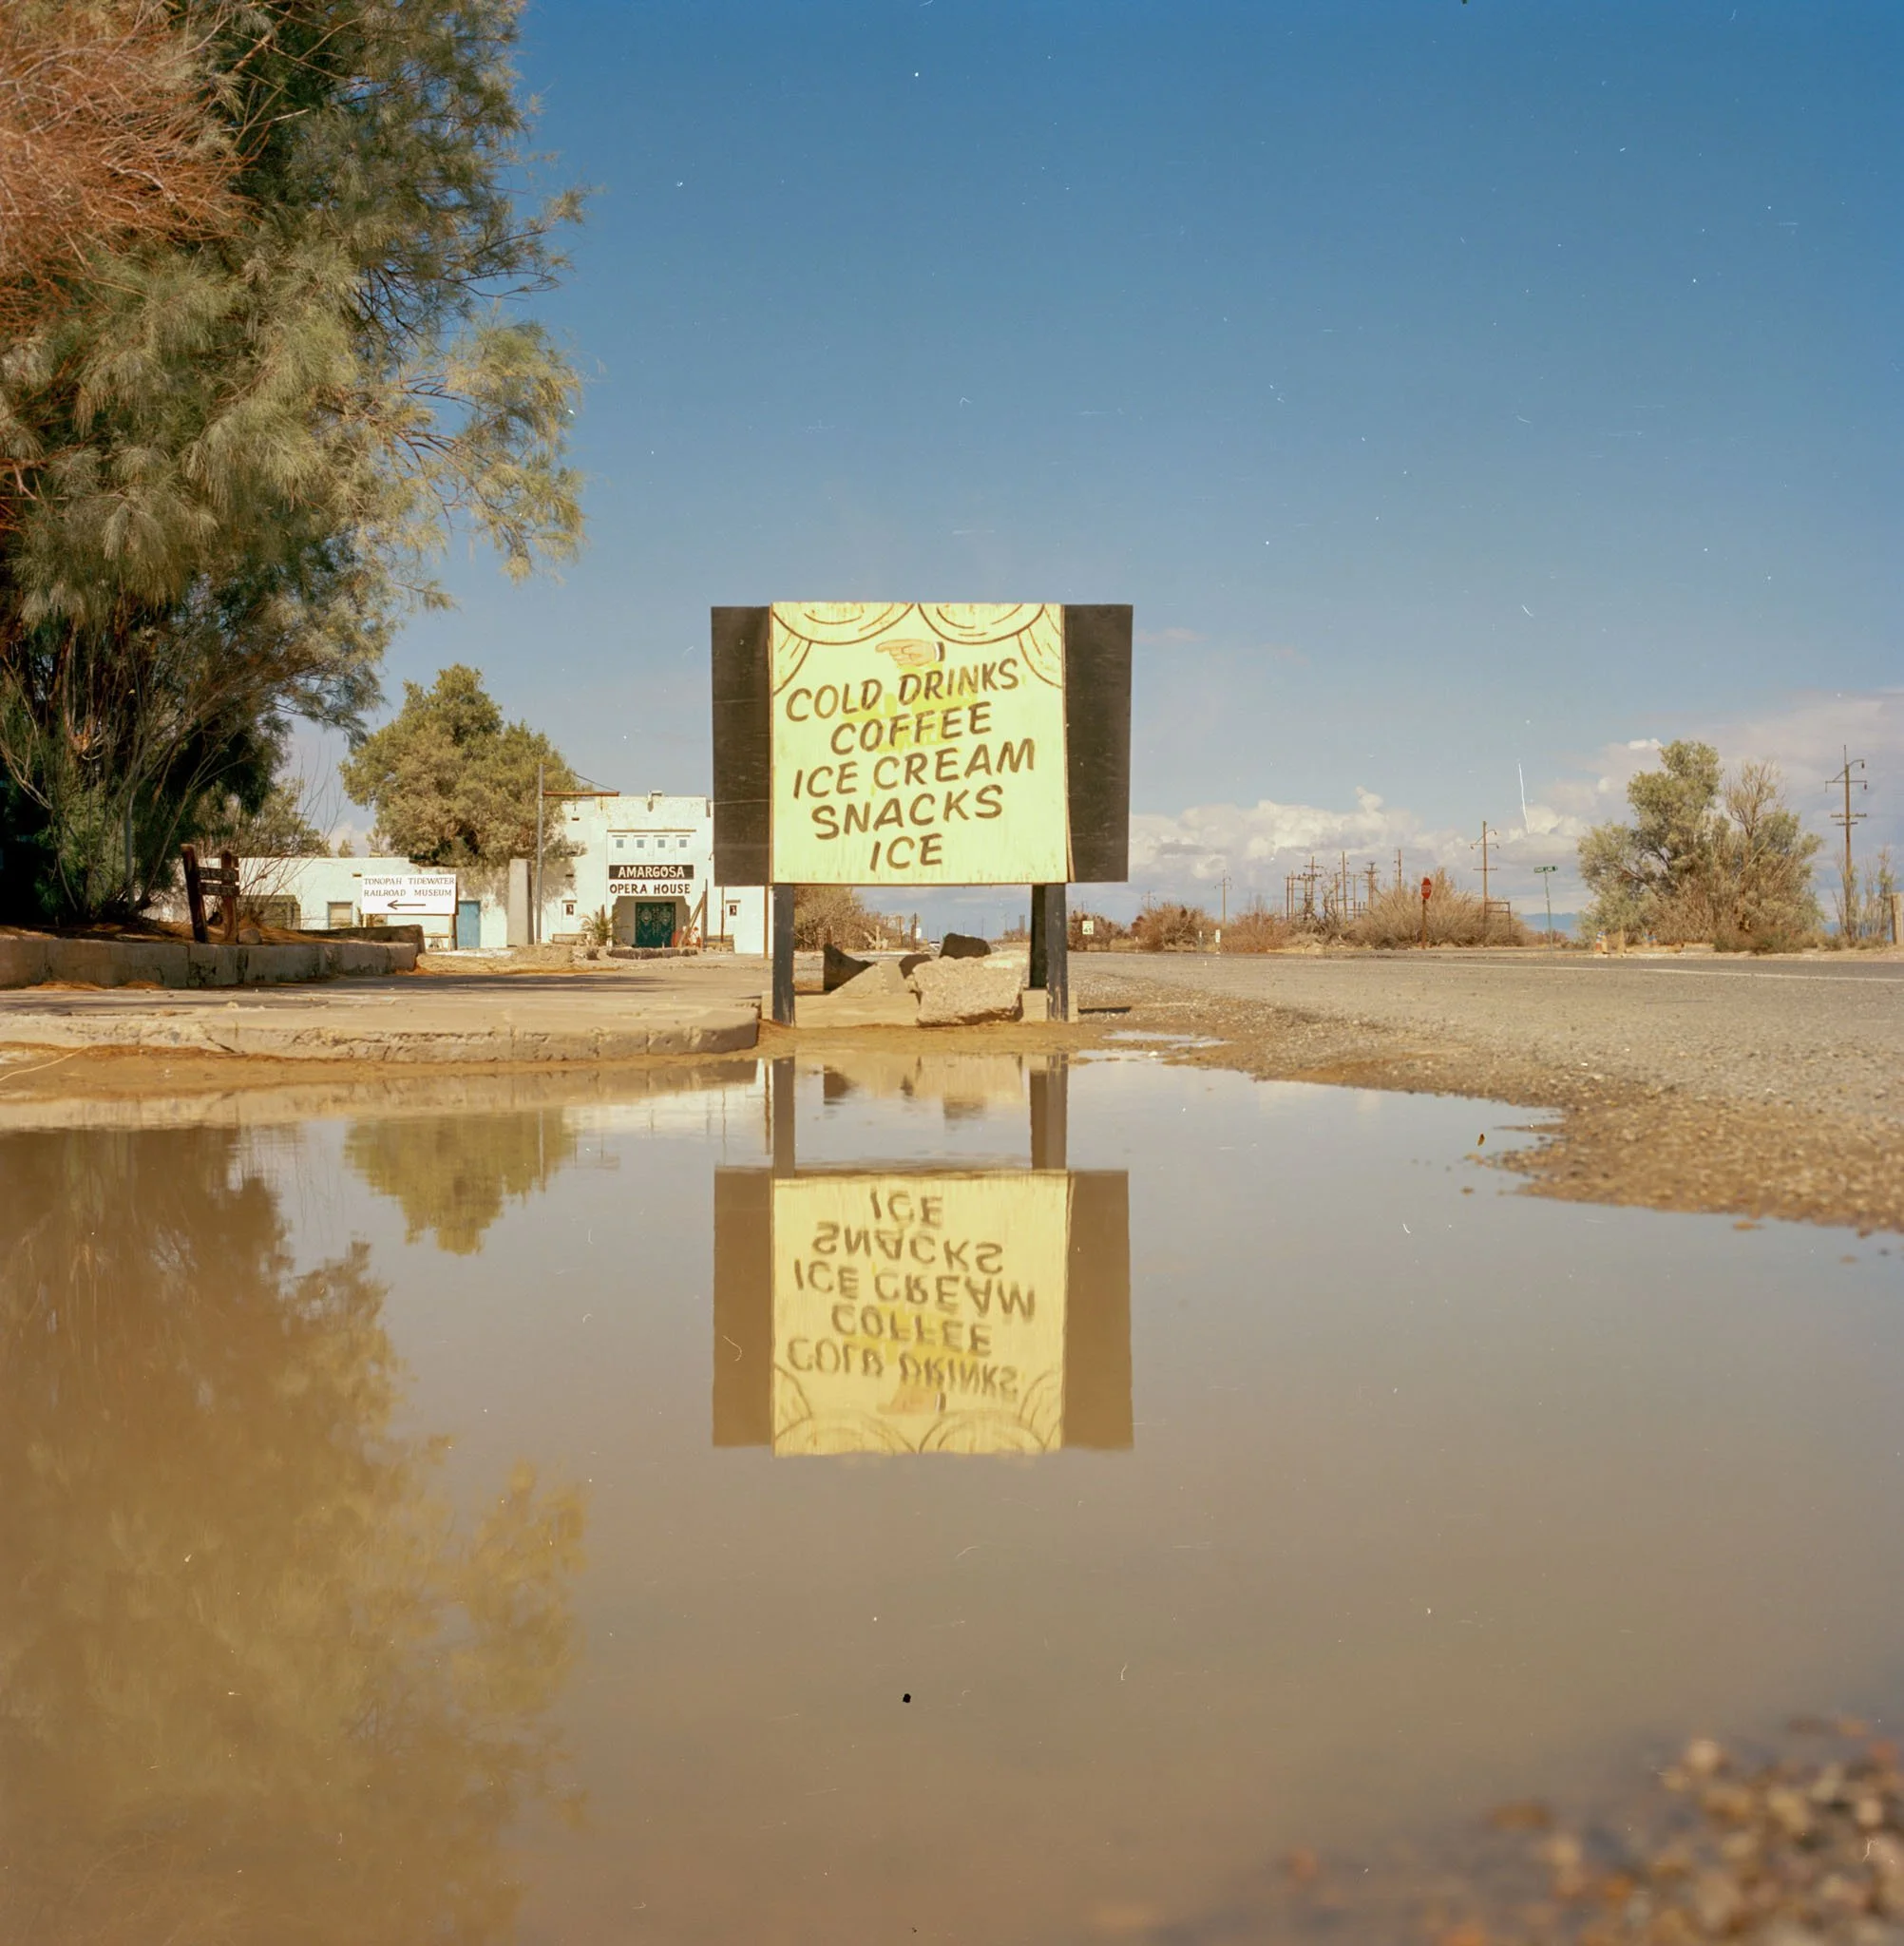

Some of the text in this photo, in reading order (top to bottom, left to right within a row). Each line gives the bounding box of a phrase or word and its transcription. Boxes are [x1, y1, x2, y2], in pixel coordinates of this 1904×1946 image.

[786, 658, 1019, 722] COLD DRINKS
[830, 700, 992, 755] COFFEE
[793, 737, 1035, 799] ICE CREAM
[811, 784, 1003, 841] SNACKS
[618, 867, 684, 878] AMARGOSA
[869, 832, 943, 871] ICE
[364, 877, 403, 886] TONOPAH
[609, 884, 691, 894] OPERA HOUSE
